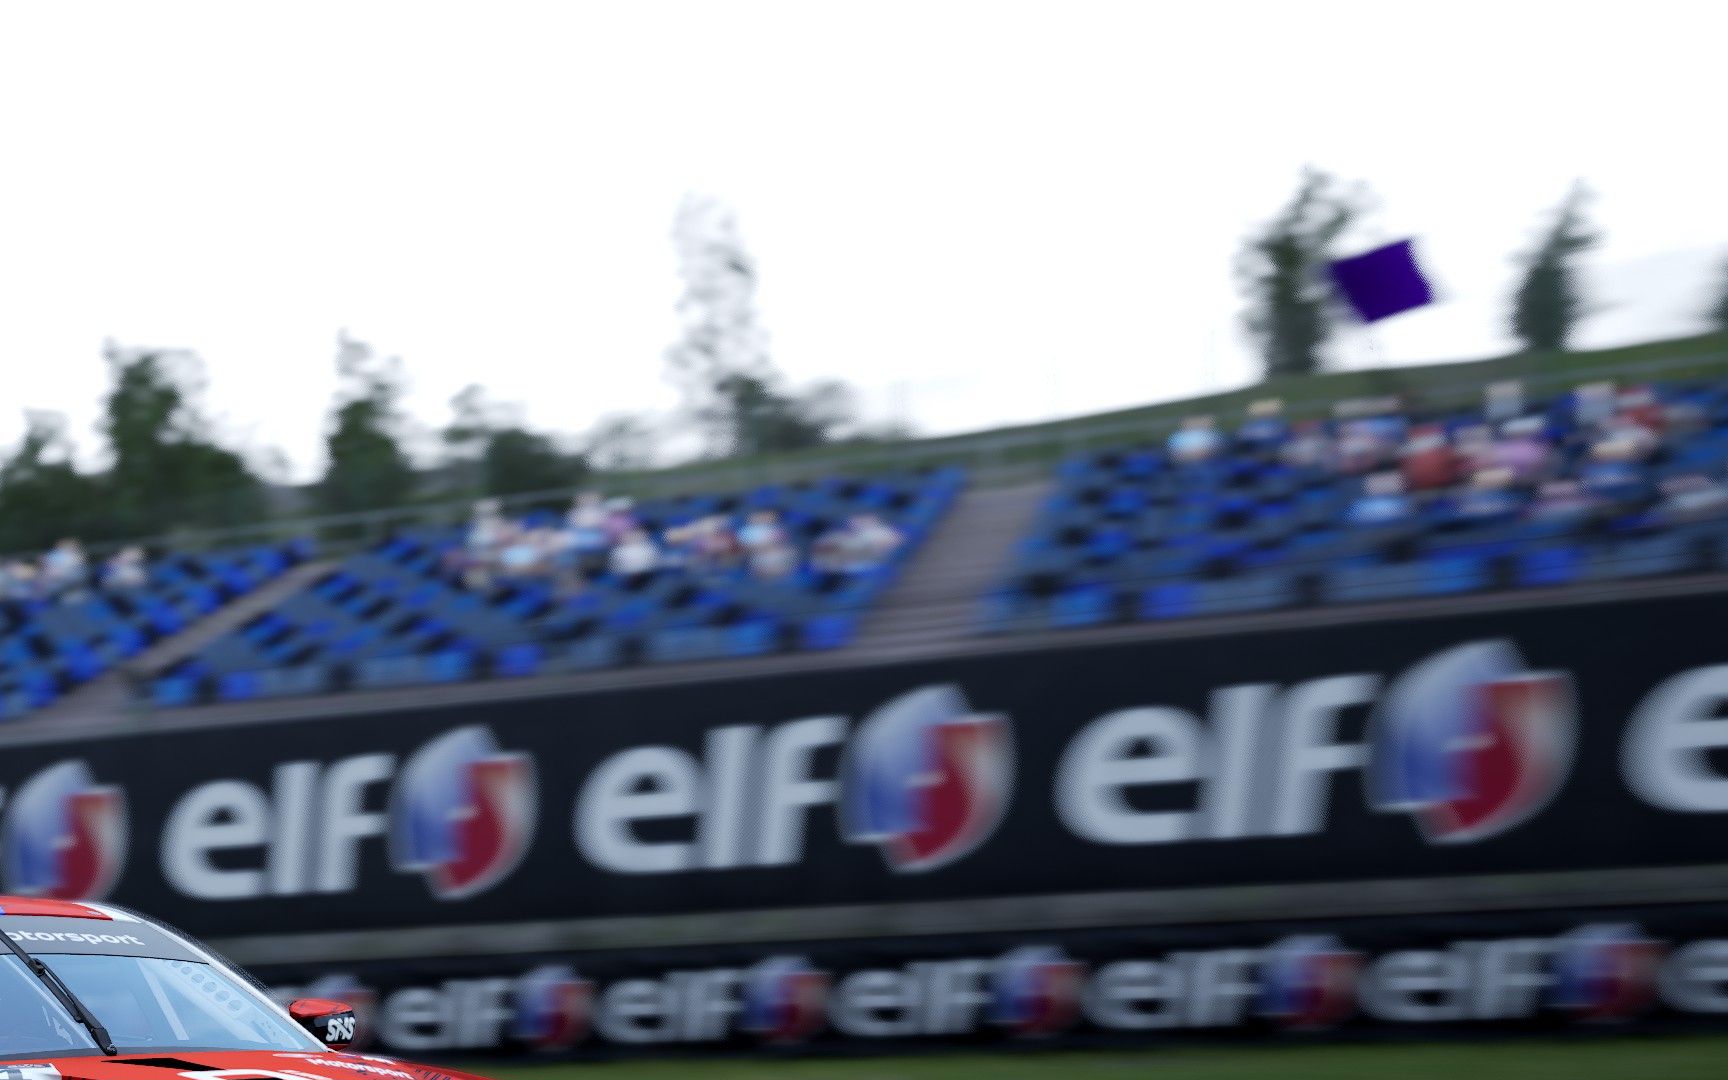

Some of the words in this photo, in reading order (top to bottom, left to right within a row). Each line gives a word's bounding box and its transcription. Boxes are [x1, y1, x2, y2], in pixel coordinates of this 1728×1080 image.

[161, 754, 397, 900] elf
[574, 715, 852, 875] elf
[1055, 673, 1384, 845] elf
[380, 980, 520, 1049] elf
[596, 969, 748, 1044] elf
[830, 958, 996, 1035] elf
[1083, 950, 1267, 1029] elf
[1362, 939, 1557, 1020] elf
